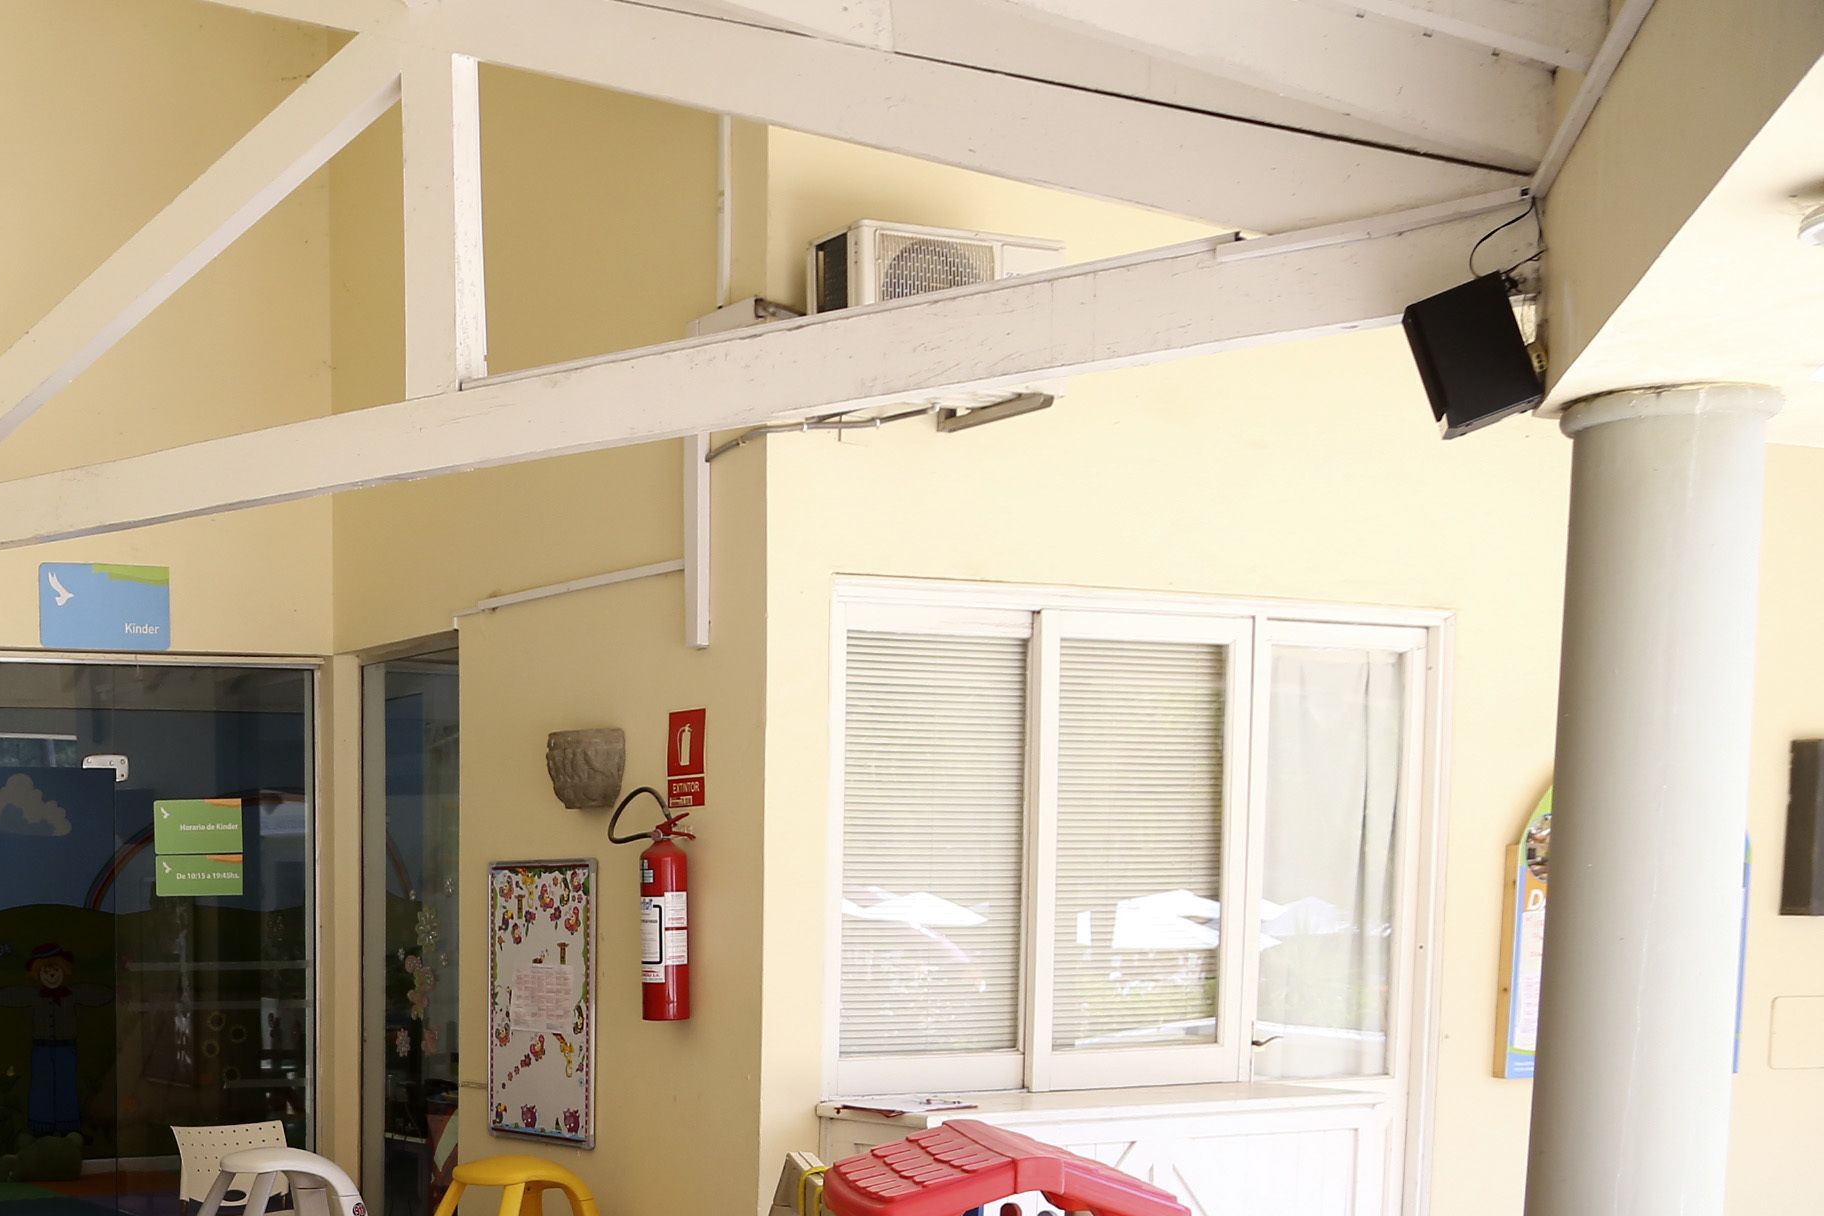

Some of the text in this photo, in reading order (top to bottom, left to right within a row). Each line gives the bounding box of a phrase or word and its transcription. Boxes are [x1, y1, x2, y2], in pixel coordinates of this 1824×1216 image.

[125, 623, 160, 634] Kinder
[672, 781, 700, 794] EXTINTOR
[180, 823, 206, 831] Horario
[216, 822, 238, 830] Kinder
[176, 872, 186, 880] De
